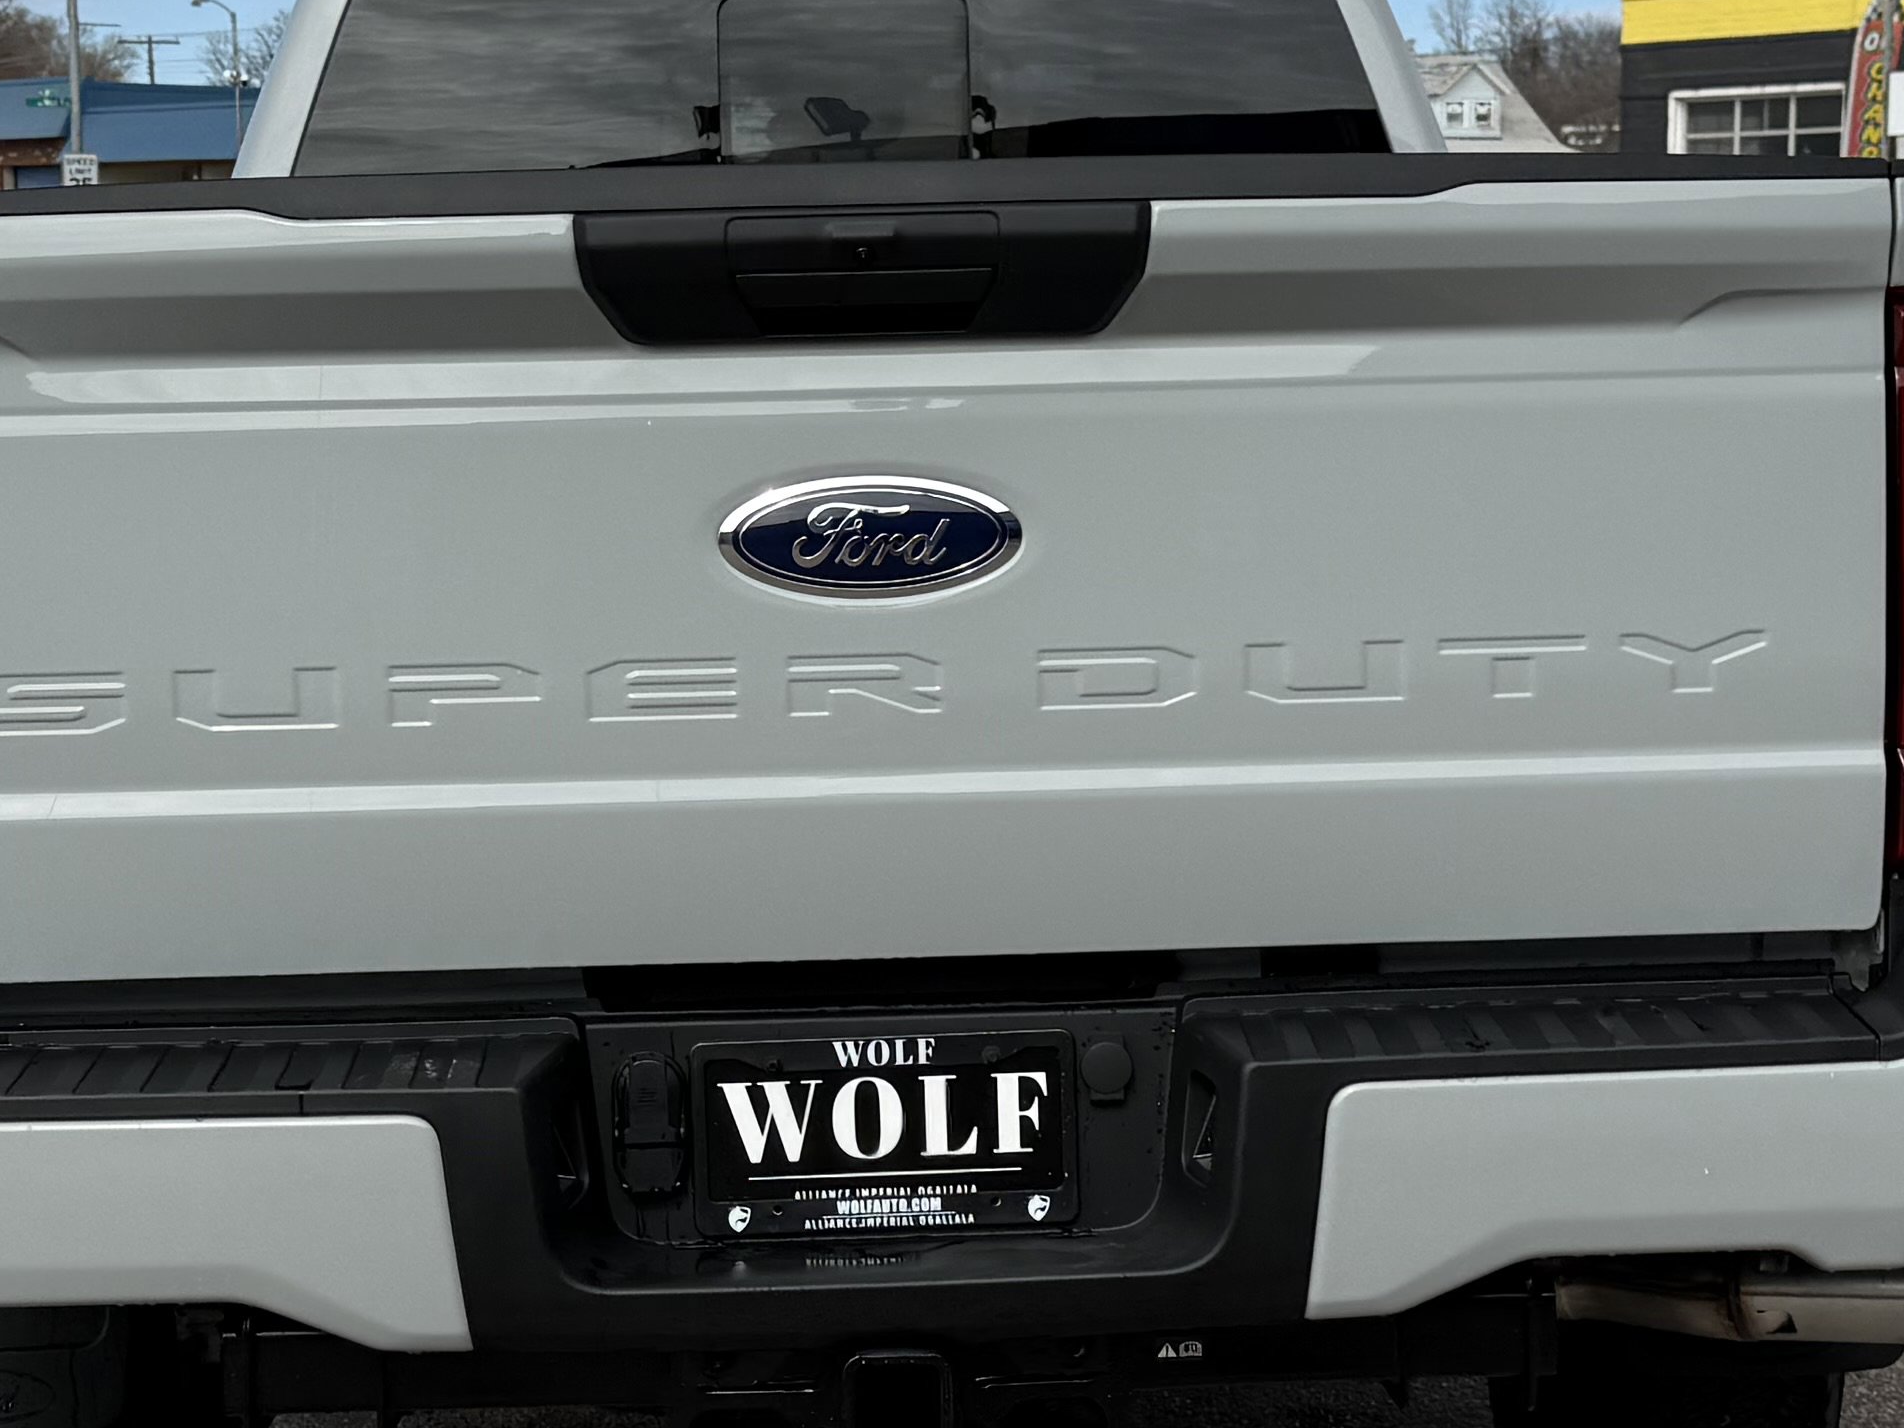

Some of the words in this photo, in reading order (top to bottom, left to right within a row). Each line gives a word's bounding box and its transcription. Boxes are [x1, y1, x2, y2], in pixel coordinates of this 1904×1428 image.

[792, 502, 951, 569] Ford
[1036, 628, 1768, 711] DUTY
[832, 1037, 936, 1068] WOLF
[716, 1070, 1048, 1165] WOLF
[836, 1197, 942, 1214] WOLFAUTO.COM
